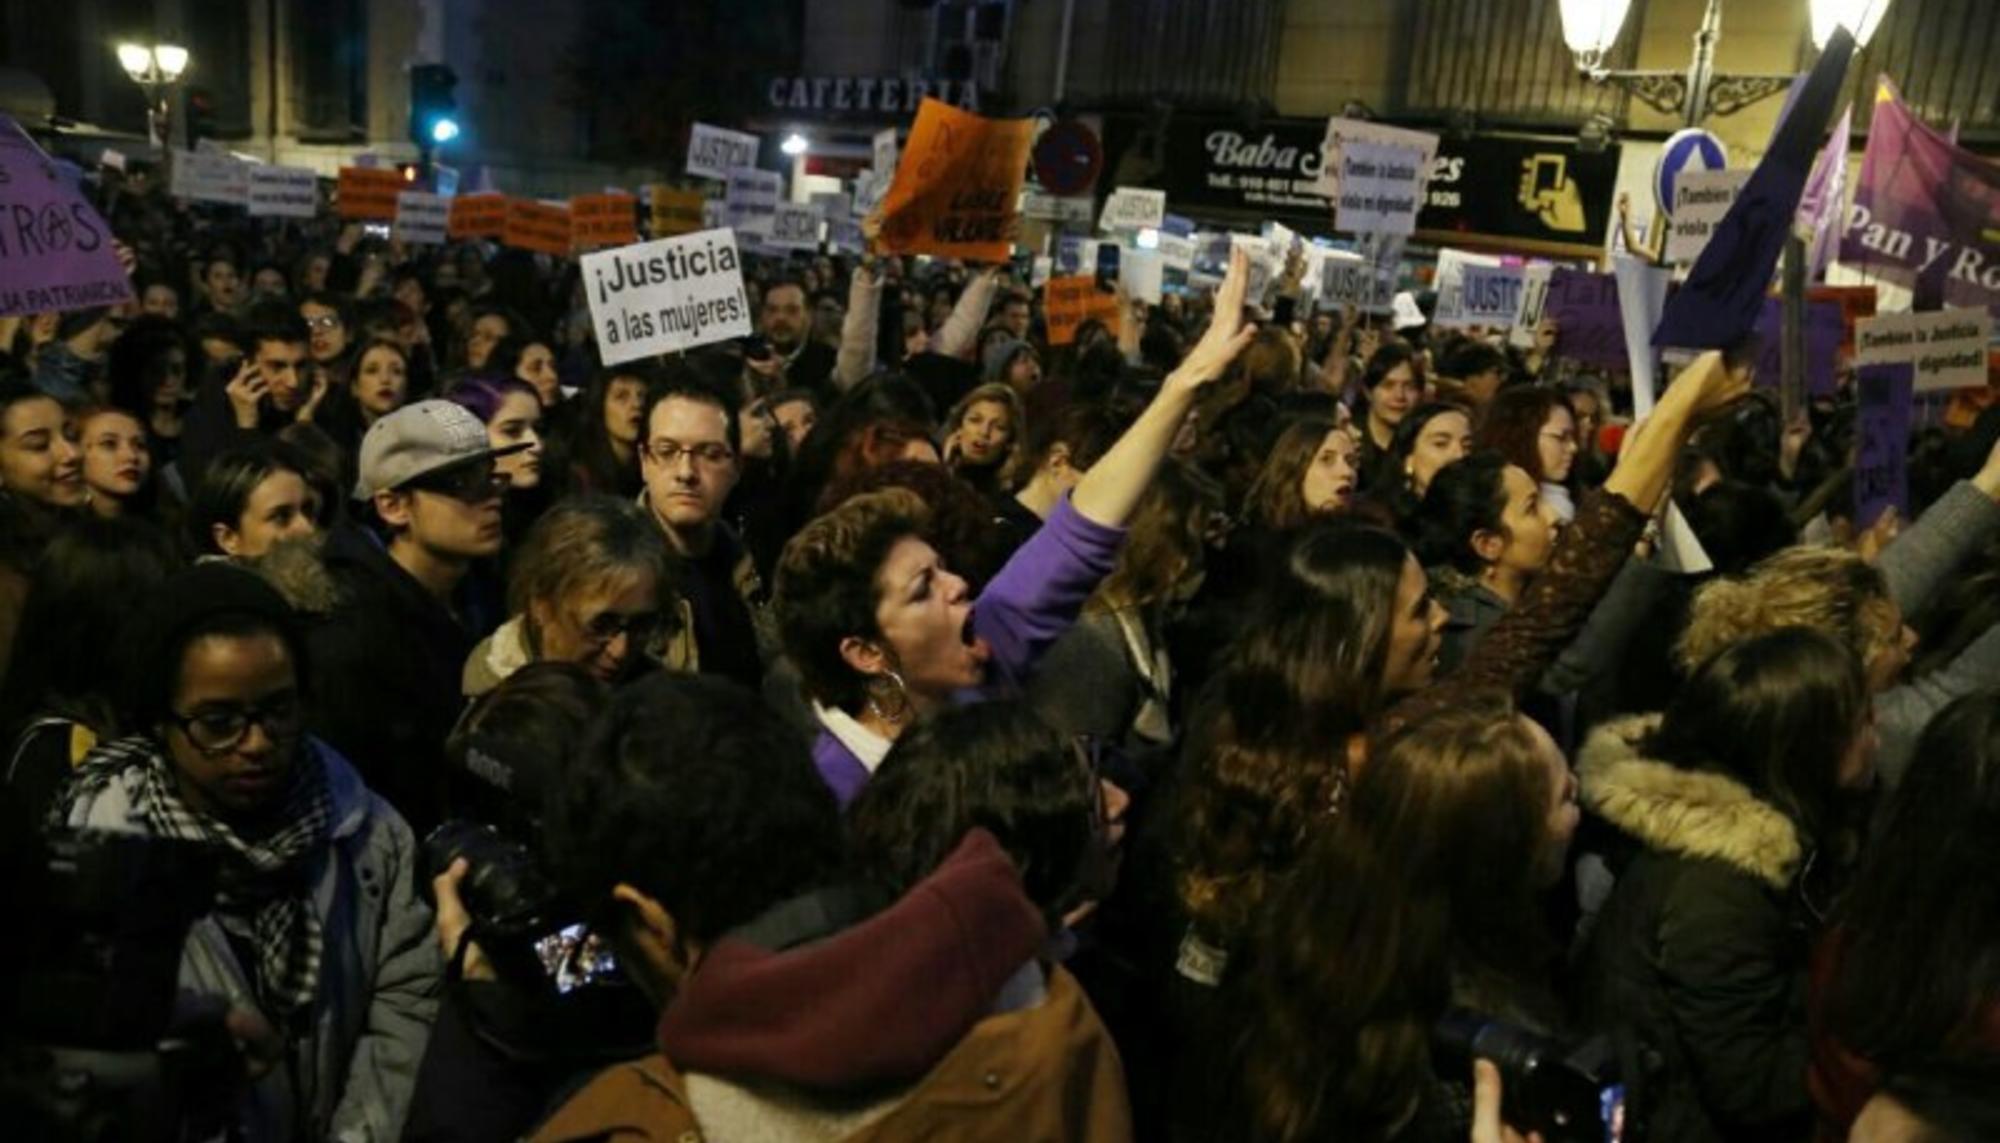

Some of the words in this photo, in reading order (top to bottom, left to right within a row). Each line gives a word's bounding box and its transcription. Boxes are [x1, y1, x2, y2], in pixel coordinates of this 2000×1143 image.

[768, 76, 979, 112] CAFETERIA
[1204, 131, 1298, 169] Baba
[1844, 203, 1914, 258] Pan
[1916, 236, 1951, 272] y
[596, 240, 736, 304] ¡Justicia
[606, 317, 620, 344] a
[621, 307, 655, 341] las
[659, 286, 747, 337] mujeres!
[1928, 322, 1979, 343] Justicia
